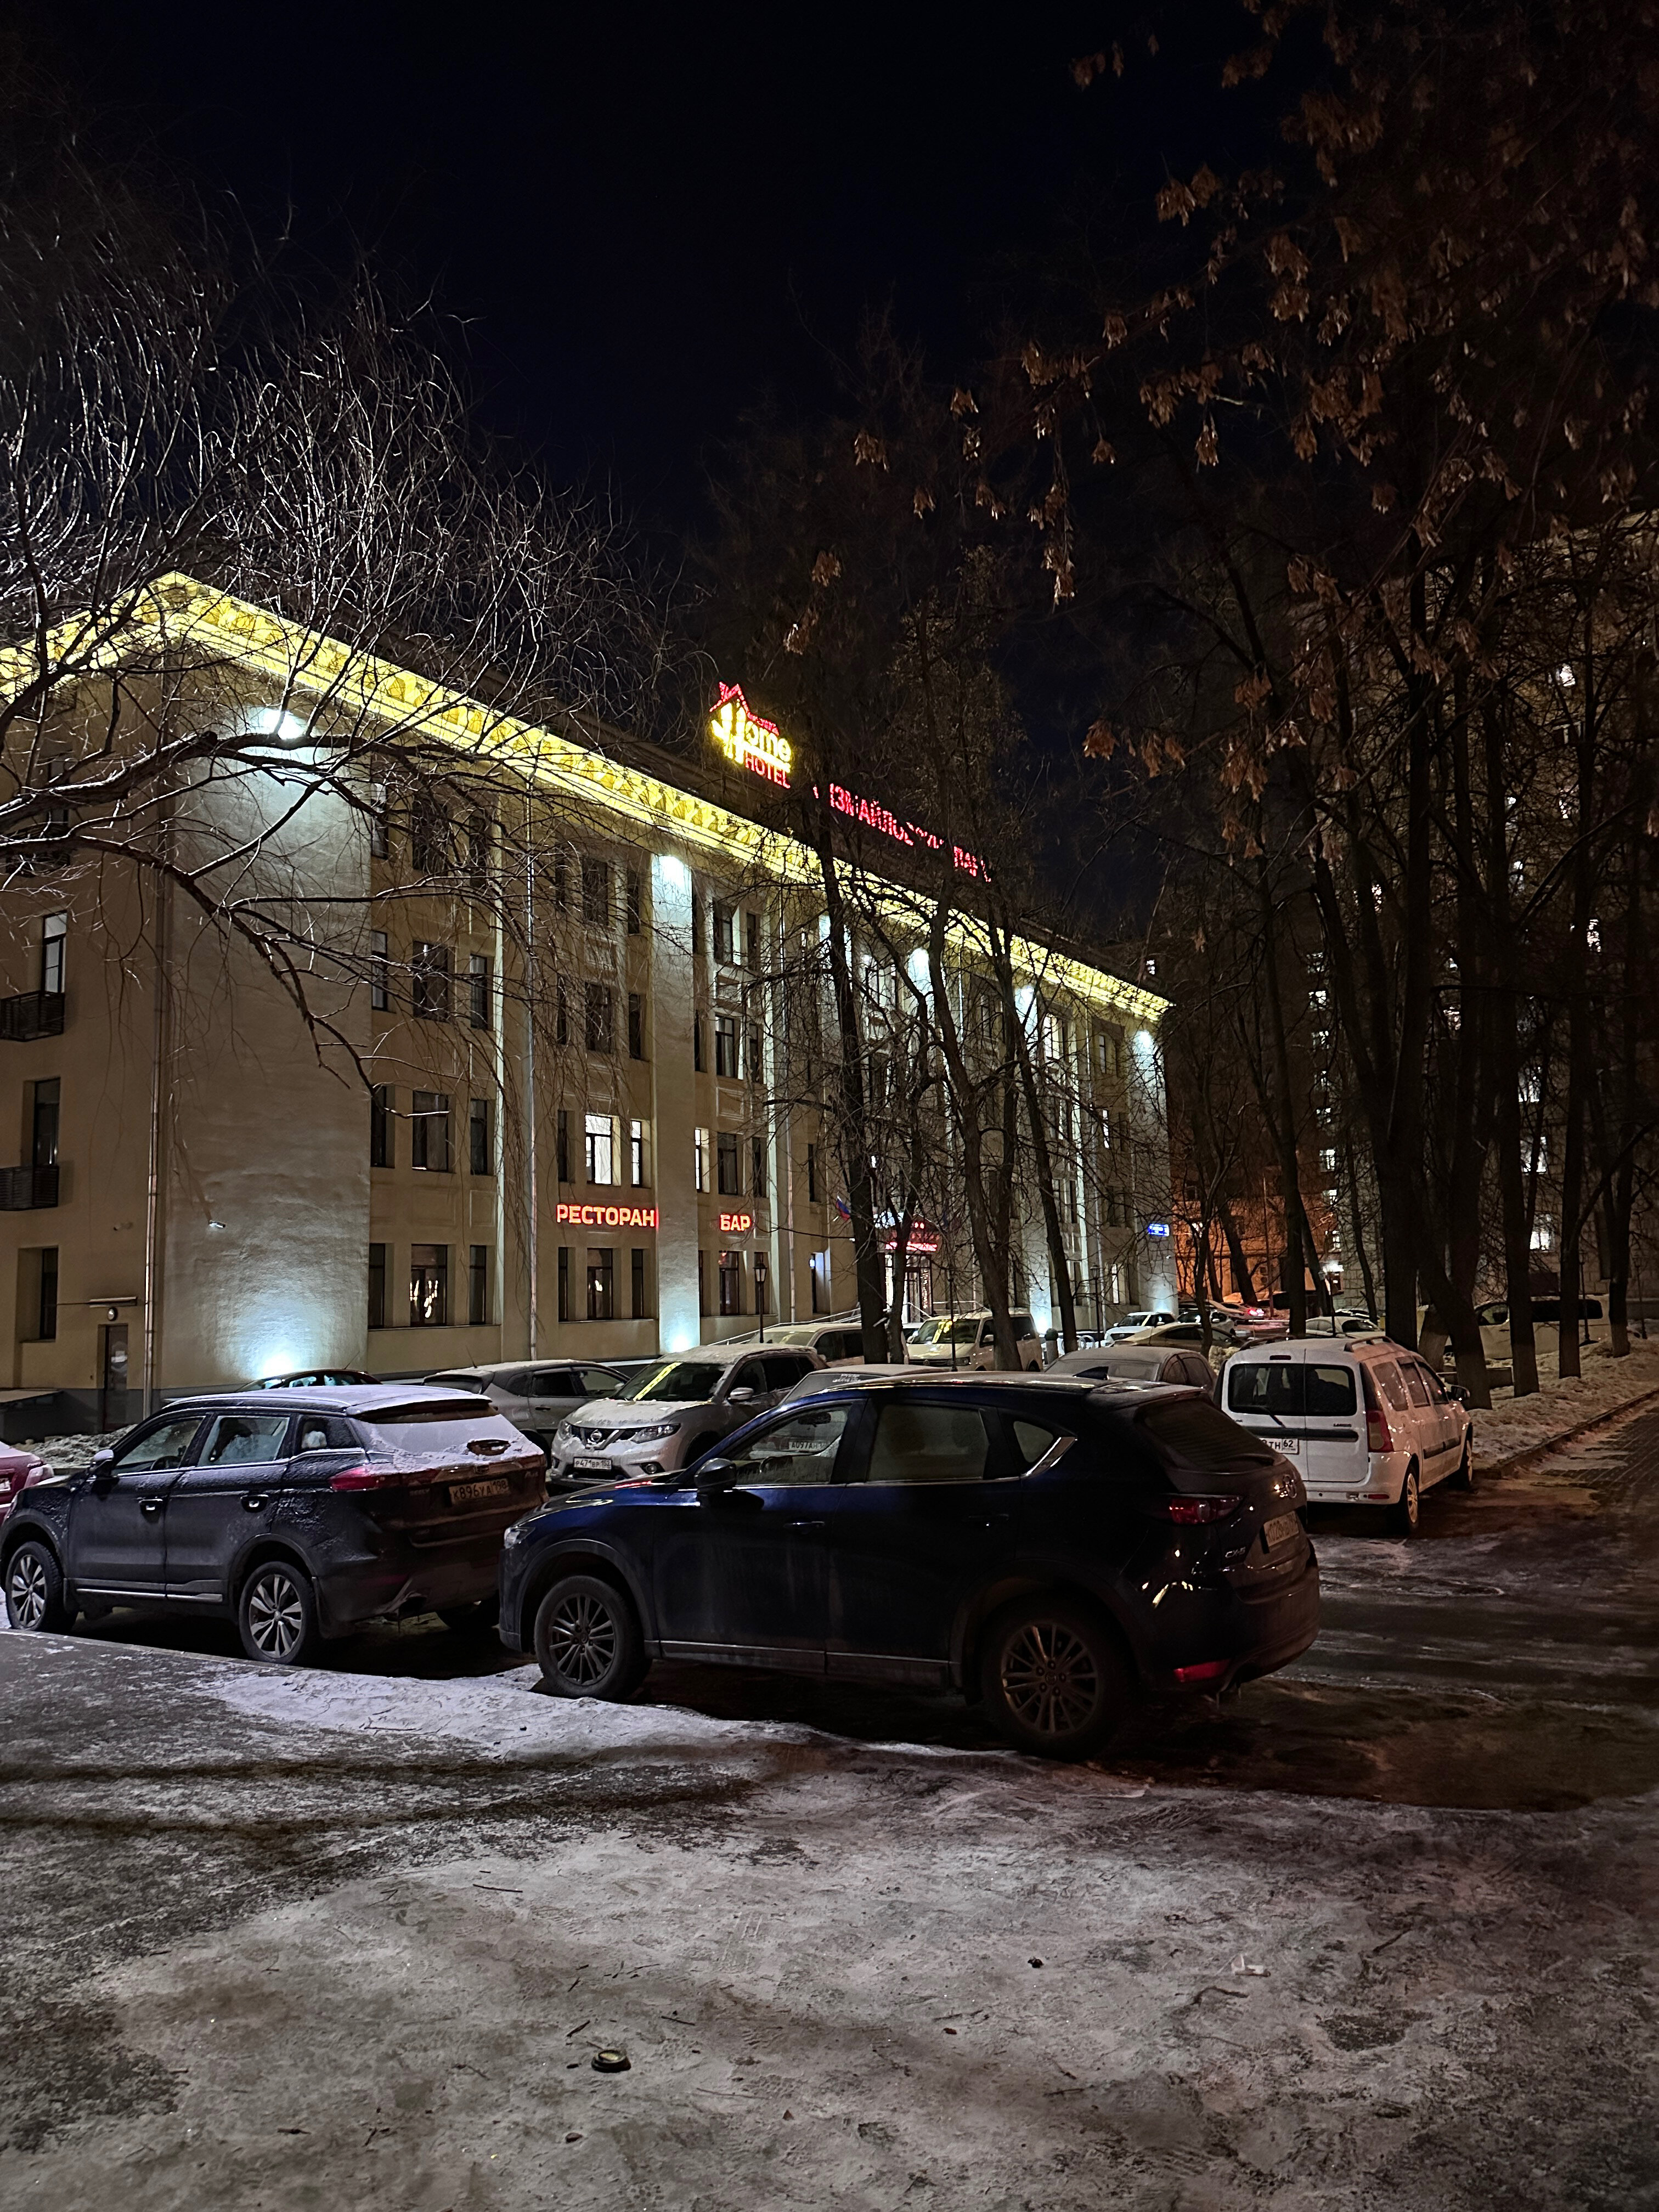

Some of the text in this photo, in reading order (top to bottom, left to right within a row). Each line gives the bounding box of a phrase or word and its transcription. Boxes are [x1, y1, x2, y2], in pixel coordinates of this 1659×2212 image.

[744, 750, 791, 788] HOTEL
[556, 1204, 655, 1227] РЕСТОРАН
[720, 1214, 751, 1231] БАР
[1283, 1440, 1294, 1448] 62
[1225, 1546, 1246, 1558] CX-5
